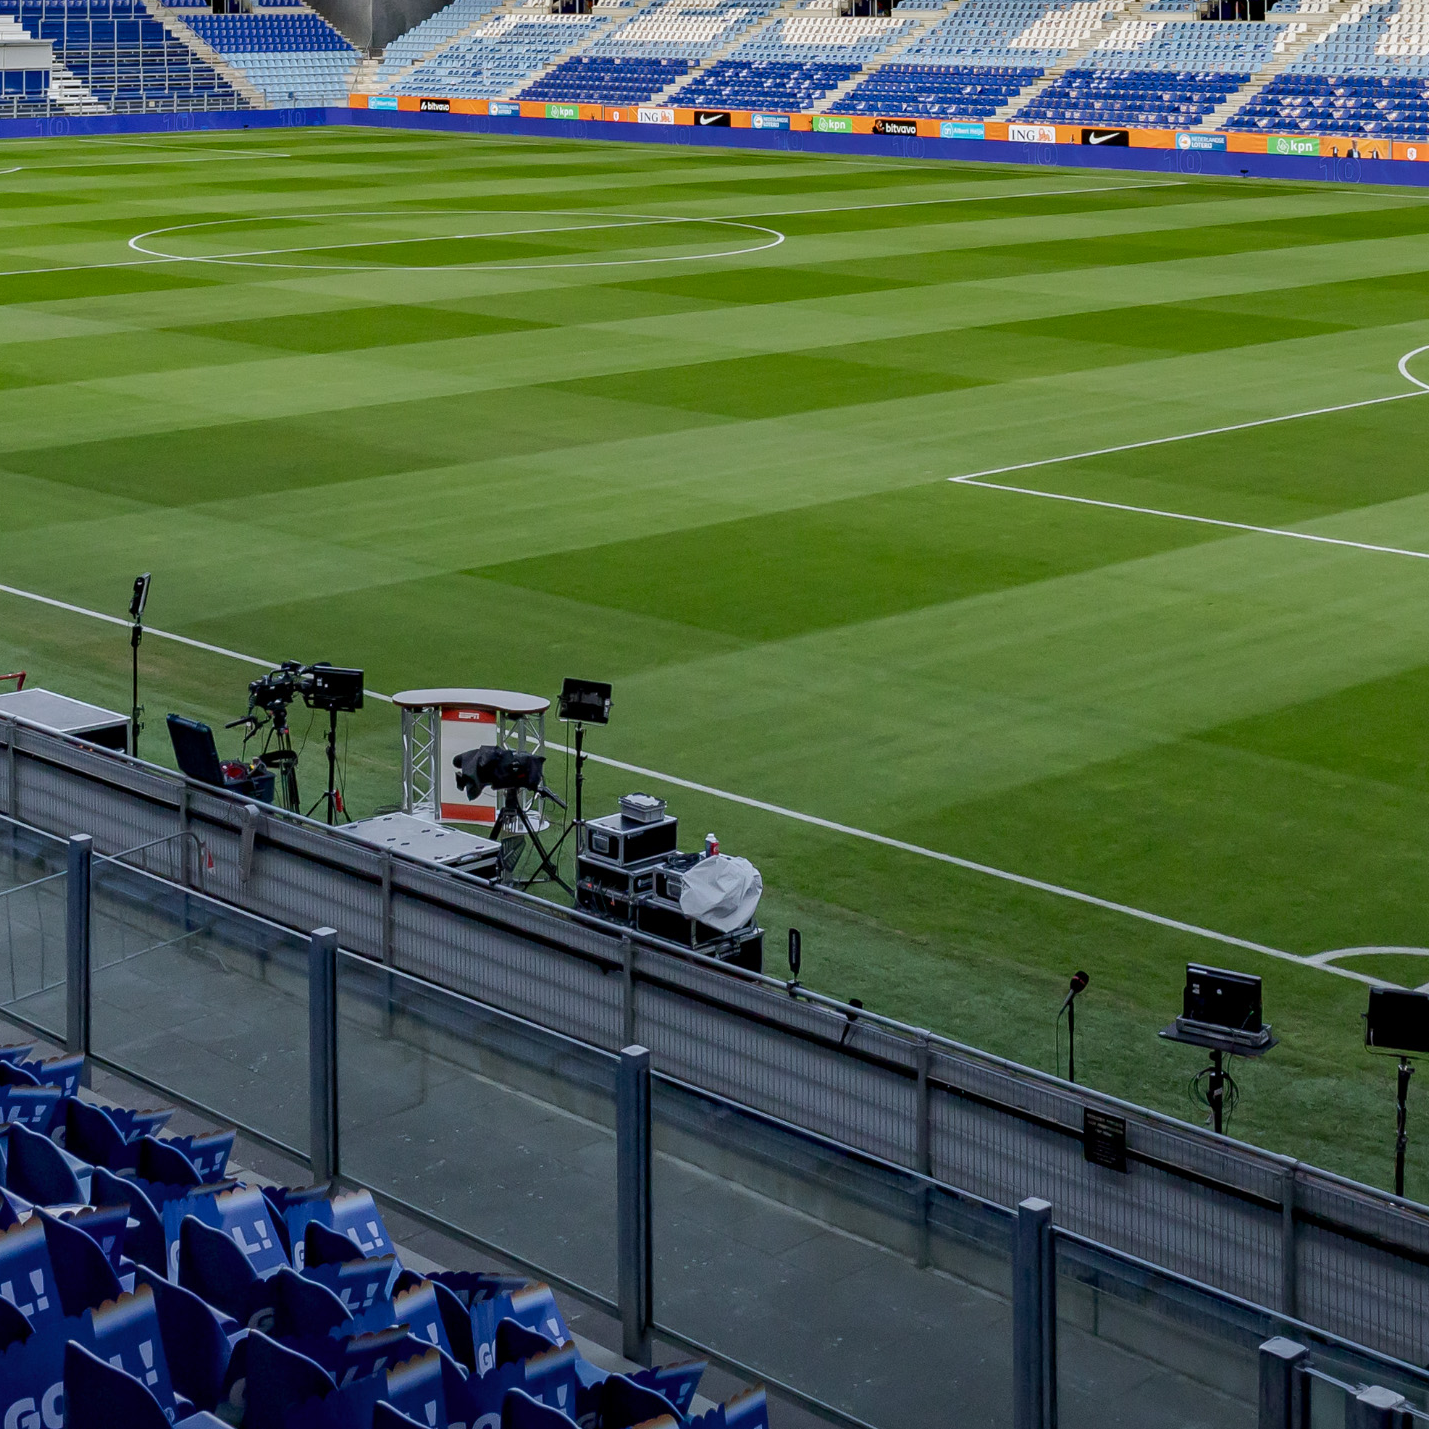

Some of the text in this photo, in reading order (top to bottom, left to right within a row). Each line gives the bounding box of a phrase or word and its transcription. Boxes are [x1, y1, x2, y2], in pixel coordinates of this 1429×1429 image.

[428, 101, 450, 112] bitvavo
[559, 106, 574, 117] kpn
[640, 111, 659, 123] ING
[36, 116, 70, 137] 10
[828, 119, 846, 131] kpn
[885, 123, 916, 134] bitvavo
[1011, 129, 1036, 141] ING
[1191, 135, 1225, 144] NEDERLANDSE
[1290, 139, 1313, 153] kpn
